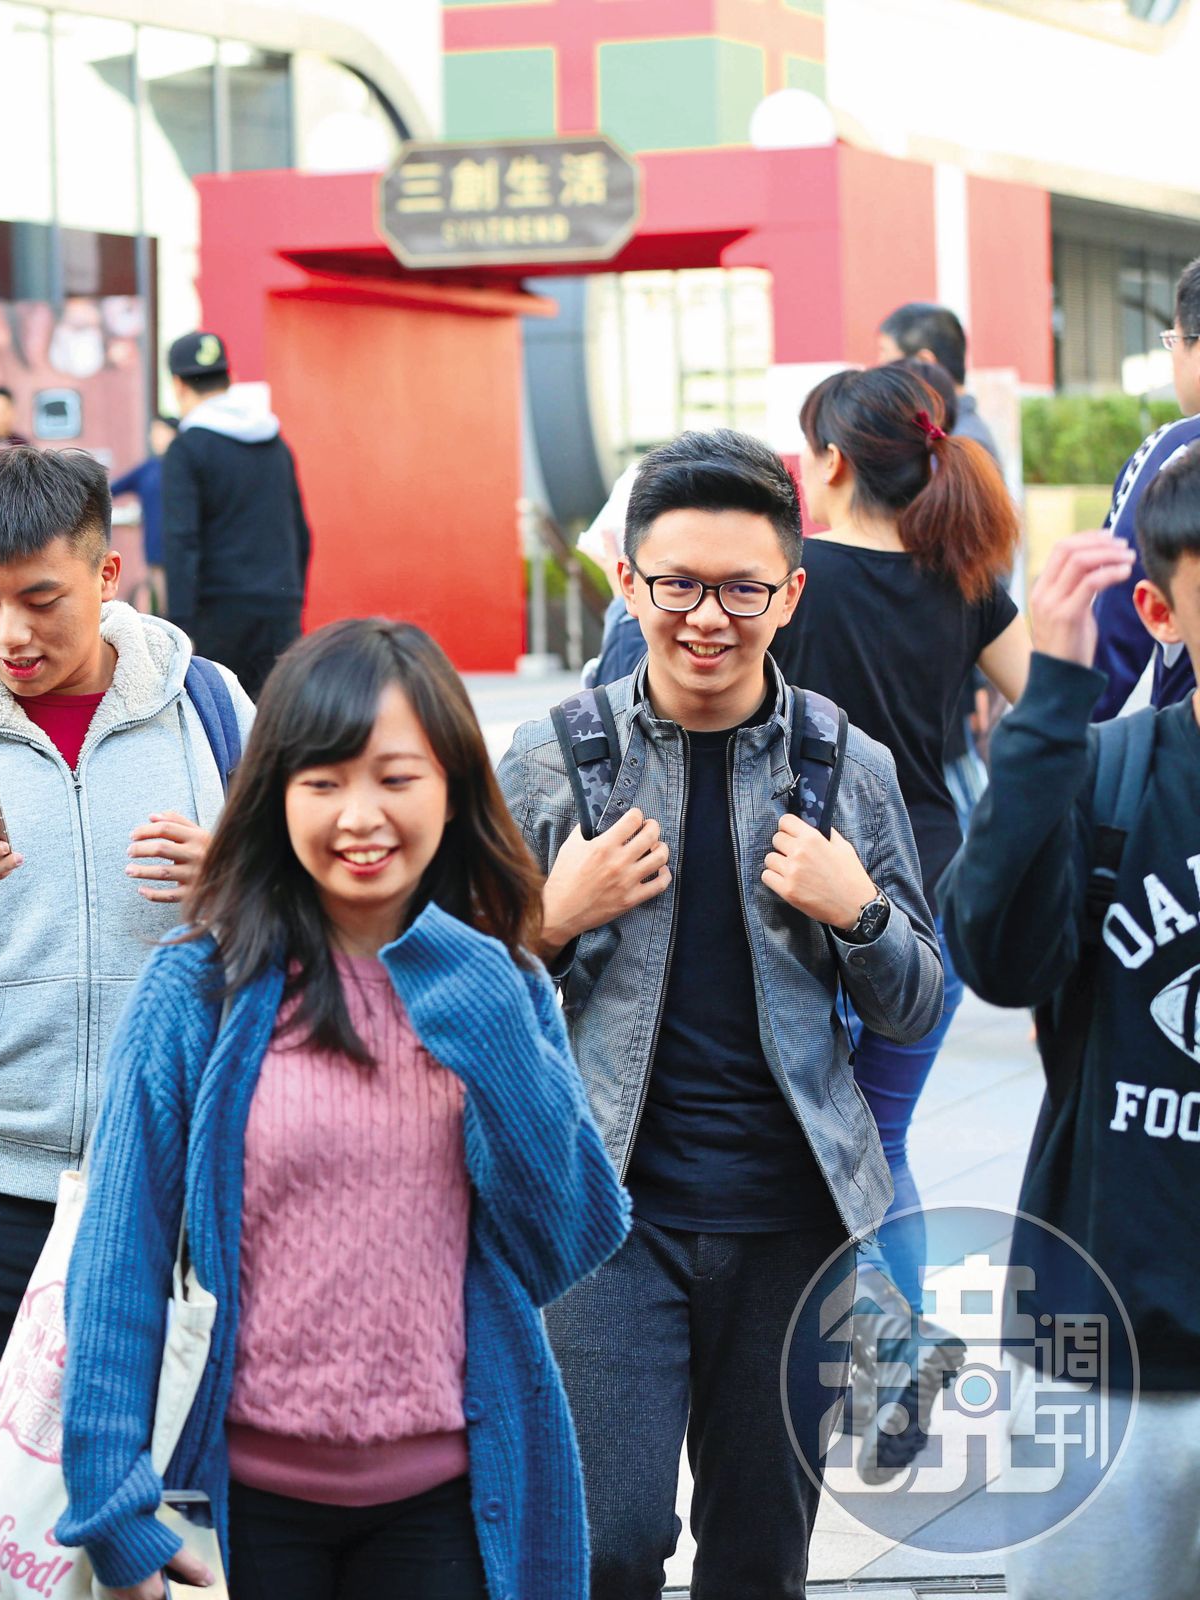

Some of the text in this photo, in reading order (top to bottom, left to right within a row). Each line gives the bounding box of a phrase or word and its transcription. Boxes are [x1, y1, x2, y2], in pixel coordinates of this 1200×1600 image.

[396, 152, 608, 213] 三創生活
[1109, 1080, 1200, 1142] FOO
